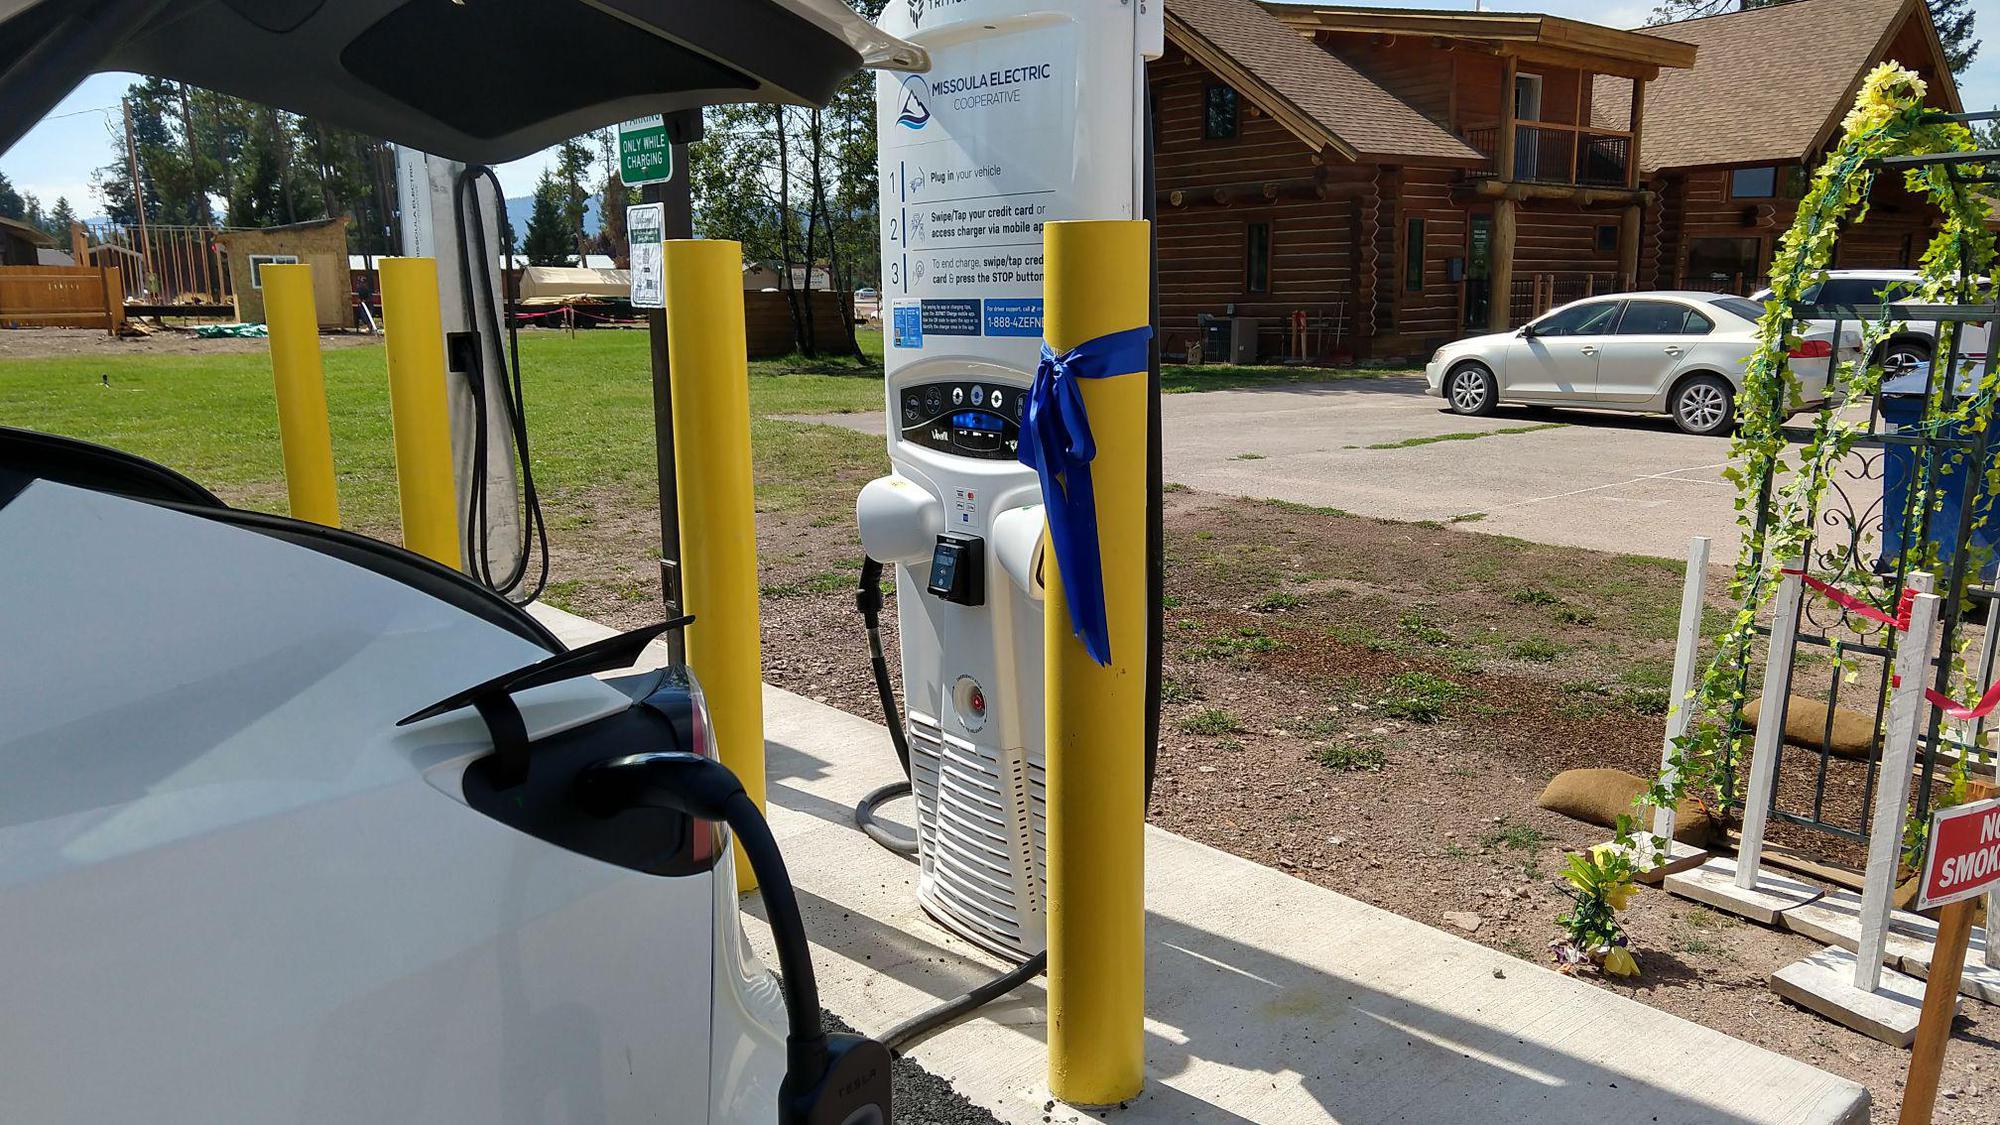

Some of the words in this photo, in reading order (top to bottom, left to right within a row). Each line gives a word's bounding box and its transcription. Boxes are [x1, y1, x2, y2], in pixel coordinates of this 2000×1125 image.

[931, 74, 988, 97] MISSOULA
[990, 63, 1051, 87] ELECTRIC
[953, 88, 1021, 111] COOPERATIVE
[622, 138, 641, 153] ONLY
[643, 134, 666, 150] WHILE
[626, 151, 663, 169] CHARGING
[889, 171, 895, 194] 1
[930, 171, 946, 184] Plug
[947, 169, 954, 181] in
[956, 169, 972, 183] your
[974, 164, 1001, 178] vehicle
[930, 208, 967, 224] Swipe/Tap
[968, 208, 986, 222] your
[987, 205, 1012, 218] credit
[1014, 203, 1034, 216] card
[1036, 205, 1046, 215] or
[890, 218, 898, 241] 2
[931, 228, 956, 238] access
[957, 223, 987, 238] charger
[988, 223, 1000, 234] via
[1002, 221, 1031, 234] mobile
[1033, 222, 1044, 235] ap
[931, 258, 940, 269] To
[941, 257, 954, 269] end
[955, 256, 982, 270] charge,
[983, 254, 1022, 269] swipe/tap
[1024, 253, 1044, 266] cred
[891, 262, 899, 284] 3
[932, 273, 947, 284] card
[948, 273, 954, 284] &
[955, 274, 976, 286] press
[977, 272, 990, 283] the
[992, 271, 1014, 283] STOP
[1015, 271, 1044, 283] button
[987, 316, 1044, 328] 1-888-4ZEFN
[1939, 844, 2000, 888] SMOK
[838, 1068, 877, 1099] TESLA
